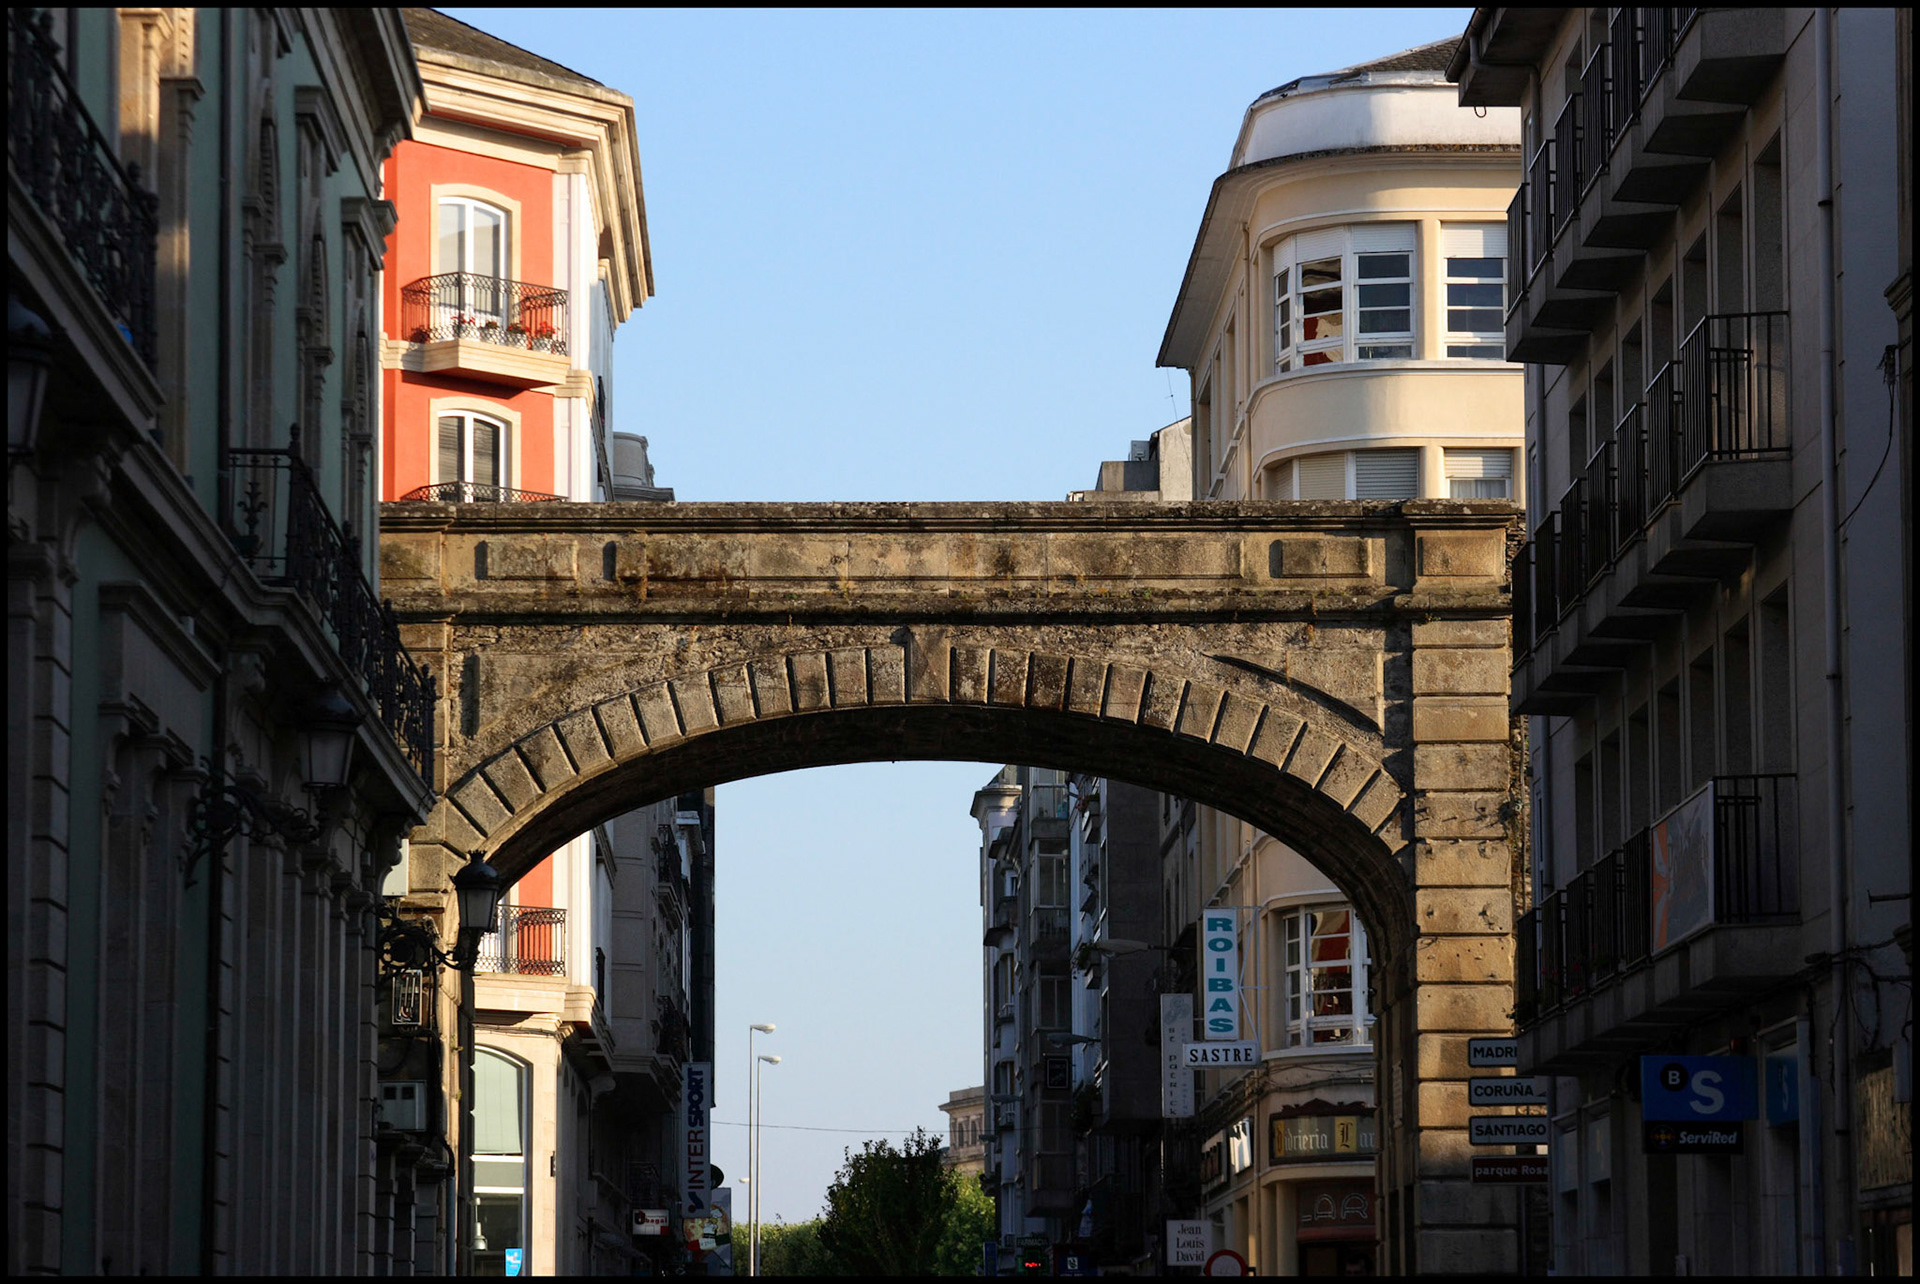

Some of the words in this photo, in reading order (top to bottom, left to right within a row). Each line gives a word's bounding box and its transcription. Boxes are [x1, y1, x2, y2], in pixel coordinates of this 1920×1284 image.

[1207, 917, 1234, 1033] ROIBAS
[1189, 1048, 1253, 1063] SASTRE
[1474, 1082, 1534, 1097] CORUÑA
[1475, 1124, 1547, 1136] SANTIAGO
[1679, 1130, 1739, 1145] ServiRed
[1475, 1166, 1518, 1177] parque
[1177, 1223, 1202, 1235] Jean
[1176, 1237, 1205, 1248] Louis
[1176, 1250, 1205, 1262] David
